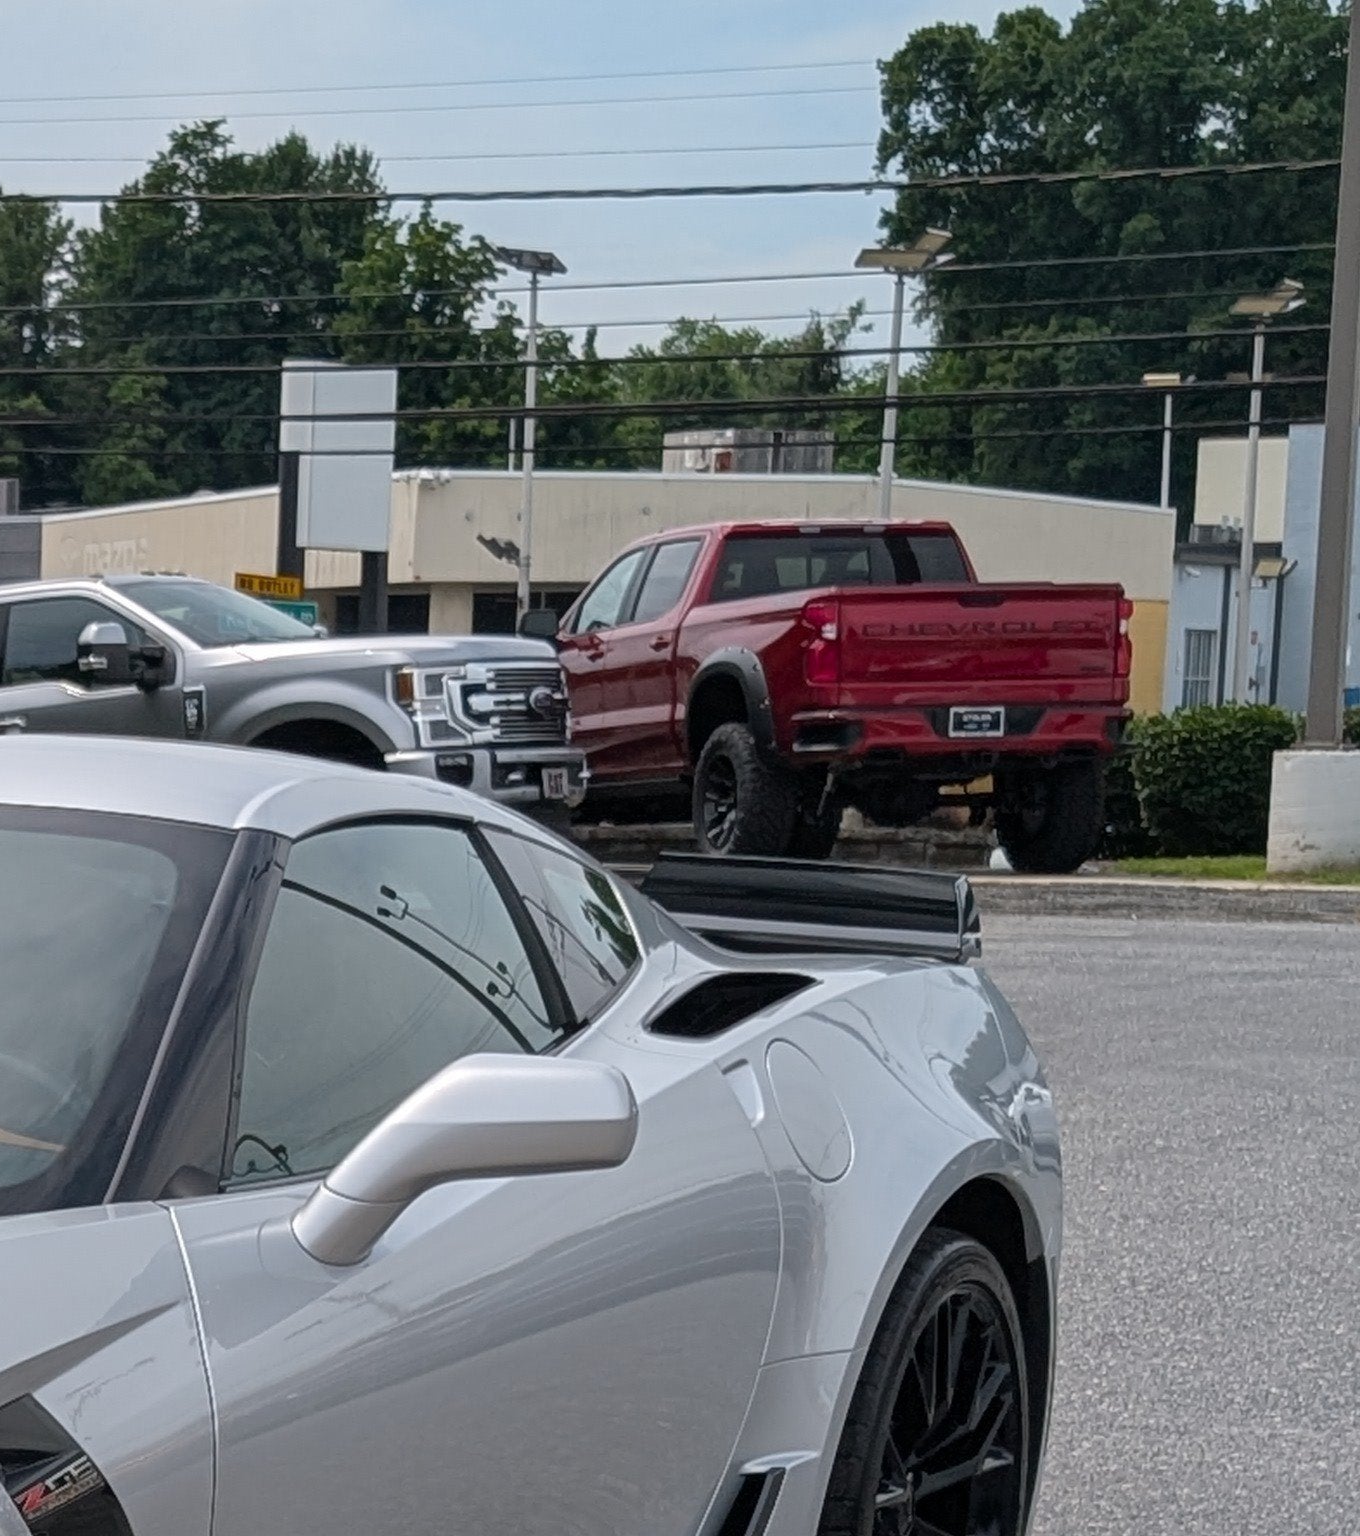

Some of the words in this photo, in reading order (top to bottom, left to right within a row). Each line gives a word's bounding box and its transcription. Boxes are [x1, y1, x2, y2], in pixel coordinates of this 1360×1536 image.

[239, 577, 254, 591] NO
[258, 580, 295, 594] OUTLET
[862, 620, 1105, 638] CHEVROLET
